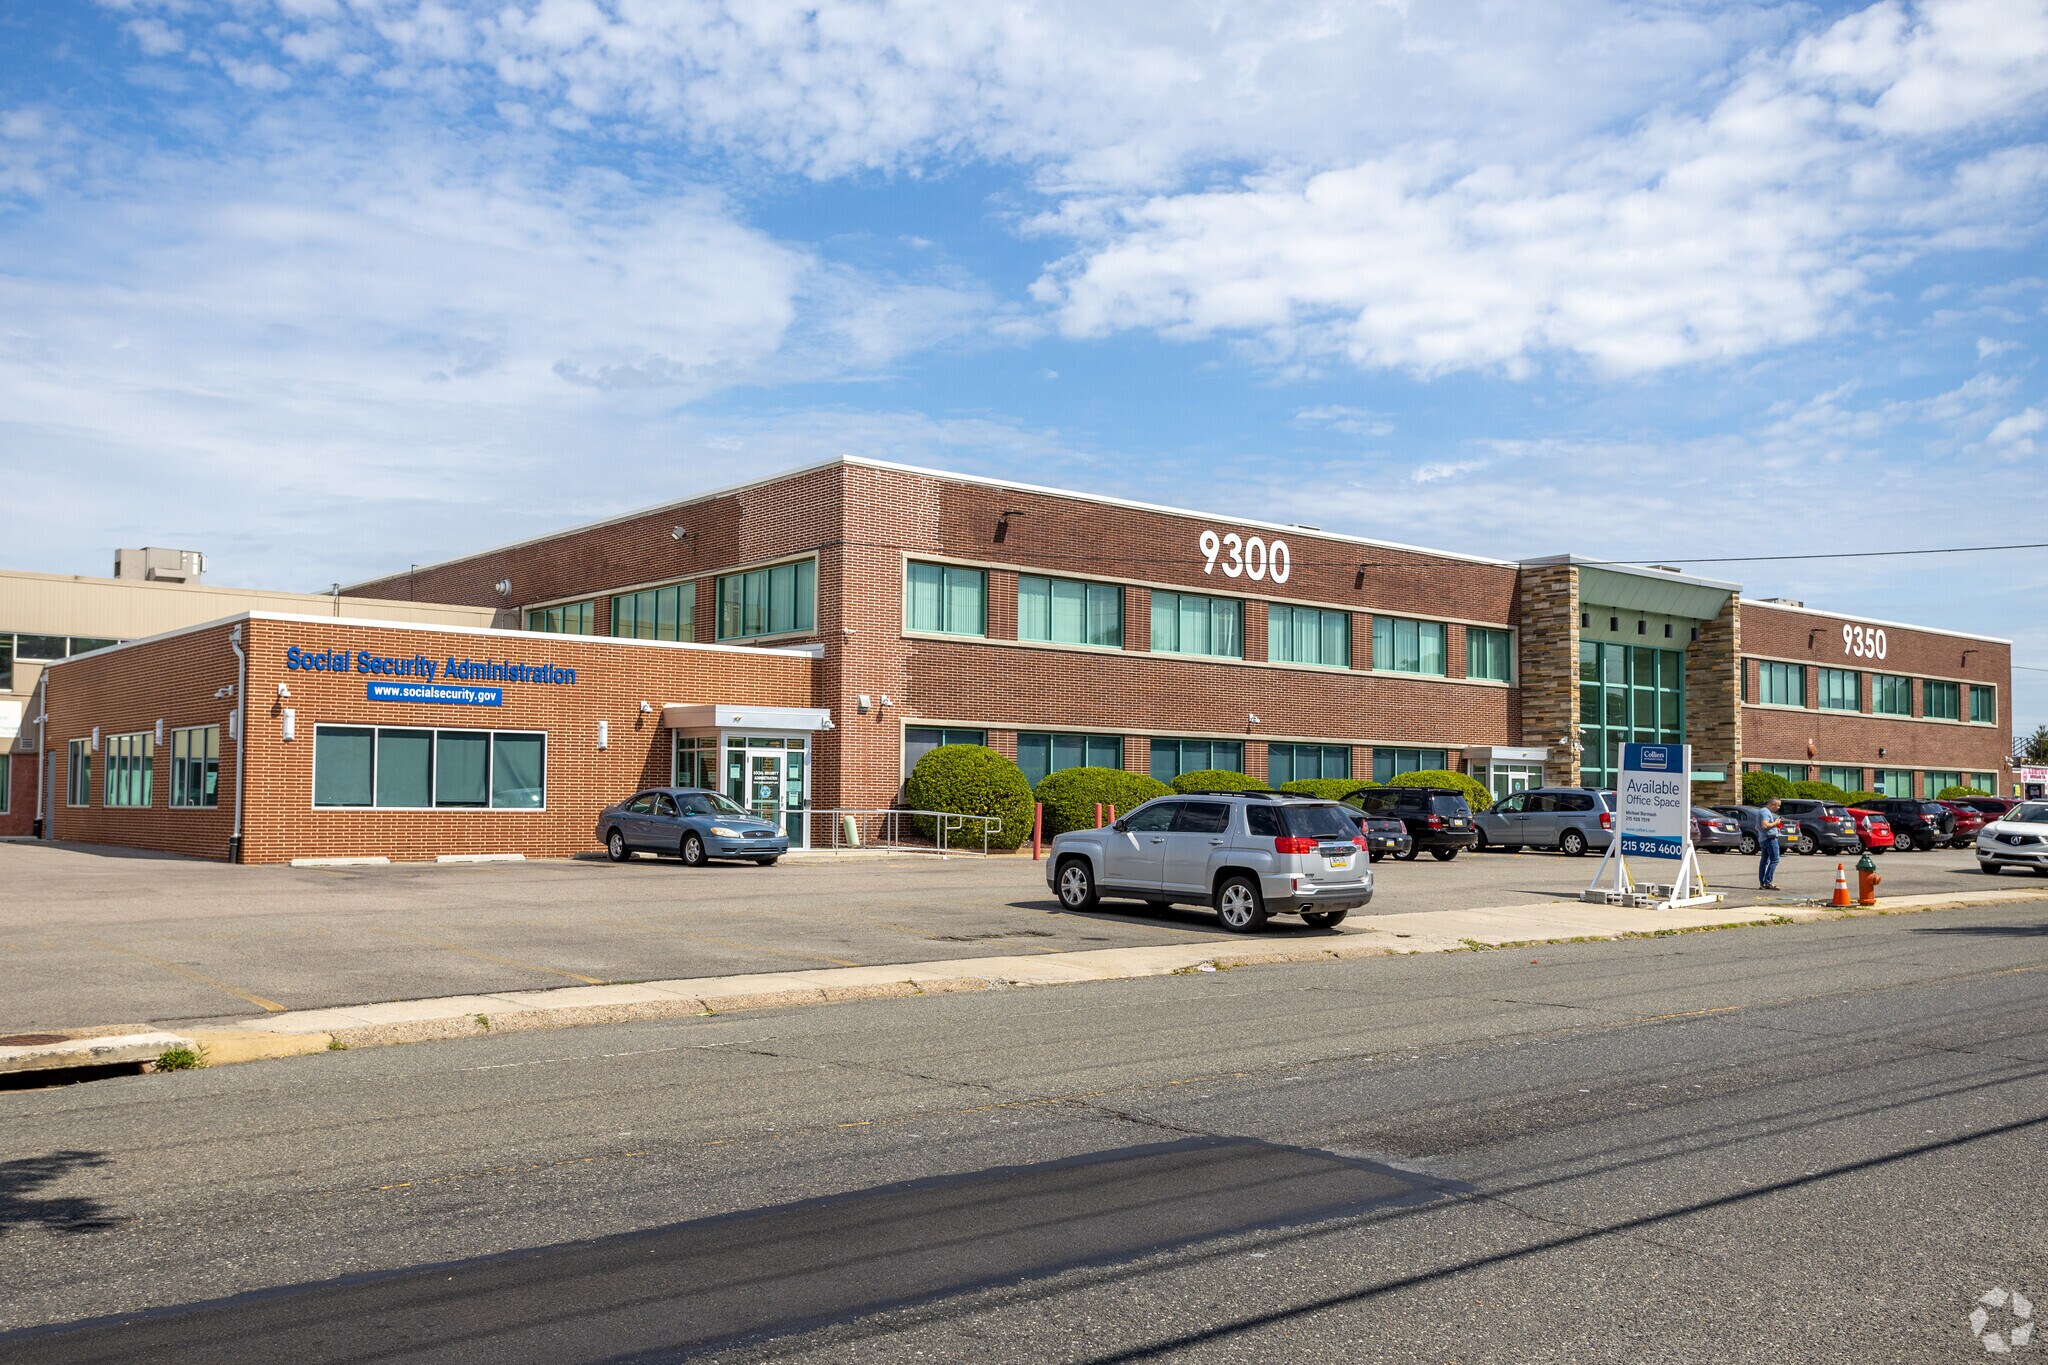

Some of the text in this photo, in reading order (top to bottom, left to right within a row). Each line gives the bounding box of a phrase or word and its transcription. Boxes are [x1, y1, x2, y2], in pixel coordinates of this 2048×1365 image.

[1199, 530, 1291, 584] 9300
[1842, 624, 1887, 660] 9350
[286, 646, 576, 684] Social Security Administration
[374, 685, 497, 703] www.socialsecurity.gov
[1643, 750, 1664, 758] Colliers
[1626, 779, 1680, 795] Available
[1626, 794, 1680, 809] Office Space
[1622, 840, 1682, 855] 215 925 4600
